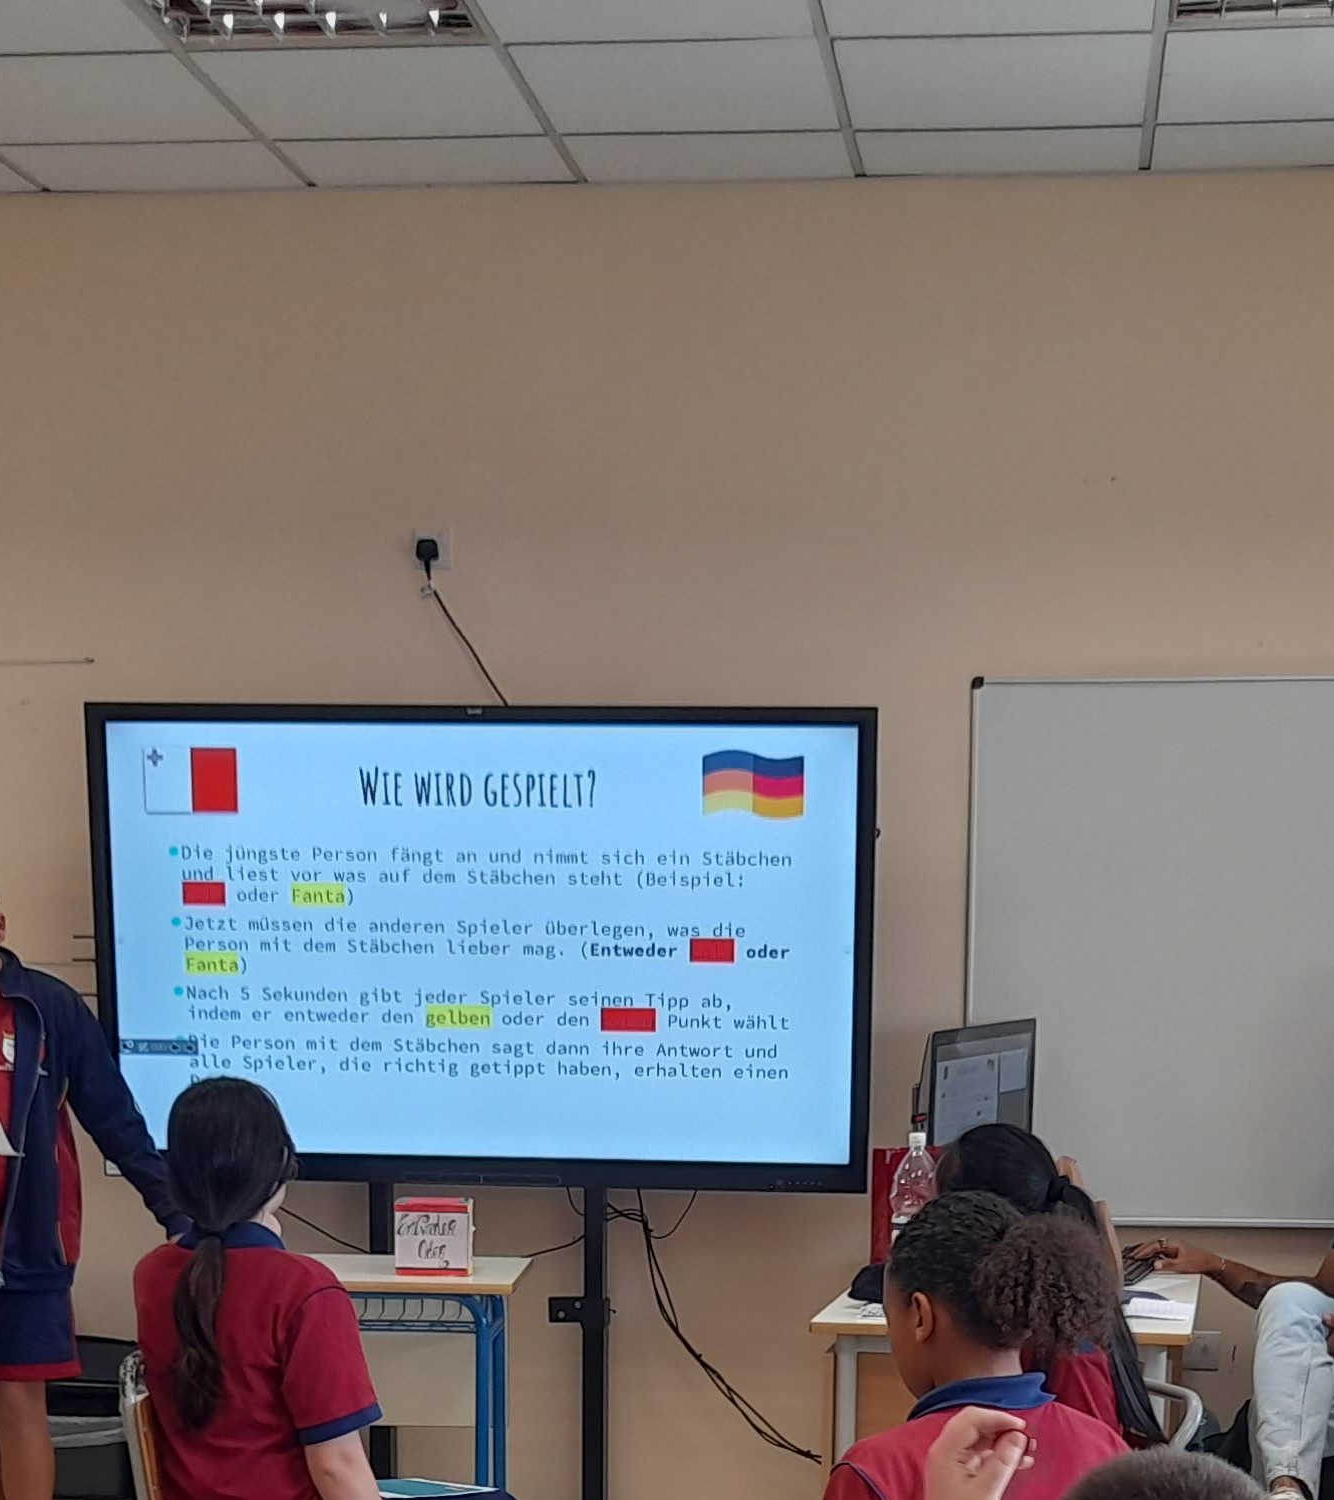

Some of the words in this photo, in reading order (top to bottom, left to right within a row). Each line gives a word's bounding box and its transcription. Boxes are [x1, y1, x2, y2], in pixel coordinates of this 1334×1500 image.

[414, 771, 472, 808] WIRD
[484, 769, 597, 809] GESPIELT?
[181, 845, 213, 861] Die
[226, 845, 301, 864] jüngste
[313, 847, 377, 862] Person
[392, 848, 443, 865] fängt
[455, 851, 478, 864] an
[489, 851, 521, 864] und
[534, 849, 588, 864] nimmt
[602, 850, 644, 865] sich
[657, 853, 690, 866] ein
[703, 851, 791, 867] Stäbchen
[182, 868, 213, 881] und
[226, 869, 279, 882] liest
[291, 872, 322, 882] vor
[334, 872, 366, 883] was
[379, 869, 411, 883] auf
[422, 869, 456, 884] dem
[467, 869, 556, 885] Stäbchen
[569, 871, 622, 886] steht
[637, 872, 744, 890] (Beispiel:
[237, 889, 279, 902] oder
[293, 888, 354, 905] Fanta)
[184, 918, 236, 932] Jetzt
[249, 918, 313, 932] müssen
[325, 918, 357, 933] die
[369, 919, 444, 933] anderen
[456, 919, 532, 936] Spieler
[546, 920, 654, 940] überlegen,
[667, 925, 699, 937] was
[713, 923, 745, 938] die
[185, 937, 248, 952] Person
[260, 939, 292, 952] mit
[303, 939, 335, 953] dem
[348, 940, 434, 954] Stäbchen
[447, 940, 511, 956] lieber
[523, 946, 564, 960] mag.
[581, 943, 677, 960] (Entweder
[747, 945, 790, 959] oder
[185, 957, 248, 974] Fanta)
[186, 987, 229, 1000] Nach
[241, 987, 249, 1000] 5
[262, 987, 348, 1002] Sekunden
[360, 988, 401, 1006] gibt
[415, 989, 467, 1008] jeder
[480, 990, 556, 1009] Spieler
[569, 992, 633, 1006] seinen
[645, 993, 689, 1010] Tipp
[701, 994, 731, 1011] ab,
[188, 1008, 241, 1021] indem
[252, 1011, 272, 1022] er
[284, 1008, 369, 1023] entweder
[382, 1009, 413, 1024] den
[425, 1008, 490, 1027] gelben
[502, 1012, 544, 1026] oder
[557, 1012, 589, 1026] den
[668, 1015, 721, 1029] Punkt
[734, 1016, 789, 1030] wählt
[188, 1035, 219, 1050] Die
[232, 1036, 295, 1051] Person
[306, 1037, 337, 1051] mit
[350, 1037, 382, 1052] dem
[394, 1038, 479, 1054] Stäbchen
[492, 1041, 535, 1057] sagt
[546, 1041, 589, 1056] dann
[603, 1042, 644, 1056] ihre
[656, 1044, 732, 1058] Antwort
[745, 1045, 777, 1059] und
[189, 1057, 231, 1068] alle
[243, 1057, 326, 1074] Spieler,
[340, 1059, 371, 1072] die
[384, 1059, 458, 1077] richtig
[470, 1061, 546, 1078] getippt
[558, 1062, 619, 1080] haben,
[635, 1063, 721, 1078] erhalten
[734, 1066, 788, 1079] einen
